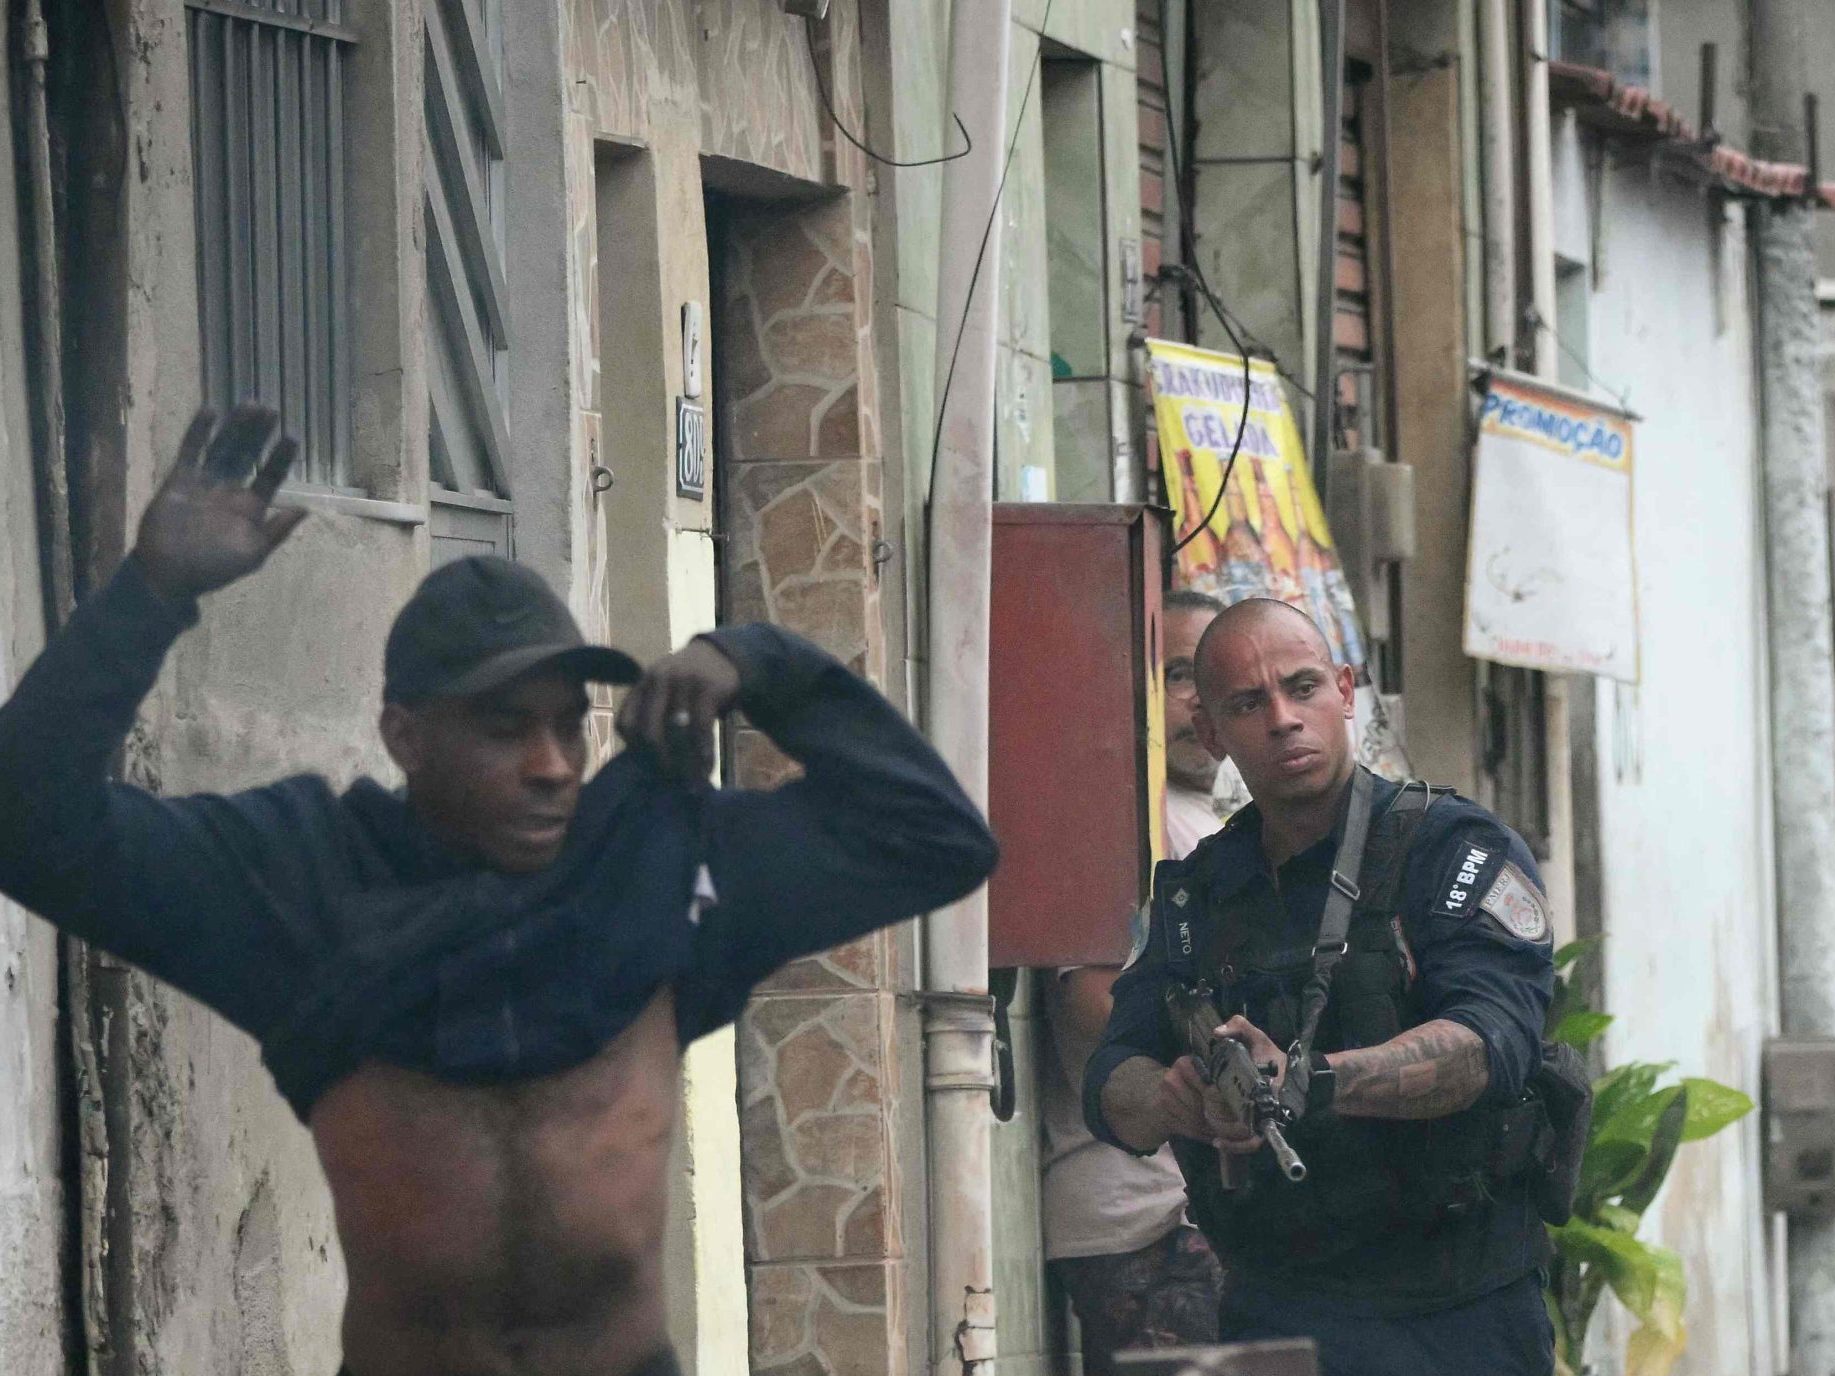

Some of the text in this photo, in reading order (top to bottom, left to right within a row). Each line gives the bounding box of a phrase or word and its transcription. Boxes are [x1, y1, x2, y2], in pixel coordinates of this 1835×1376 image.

[1481, 392, 1623, 459] PROMOÇÃO
[1456, 848, 1489, 885] BPM
[1179, 922, 1192, 954] NETO
